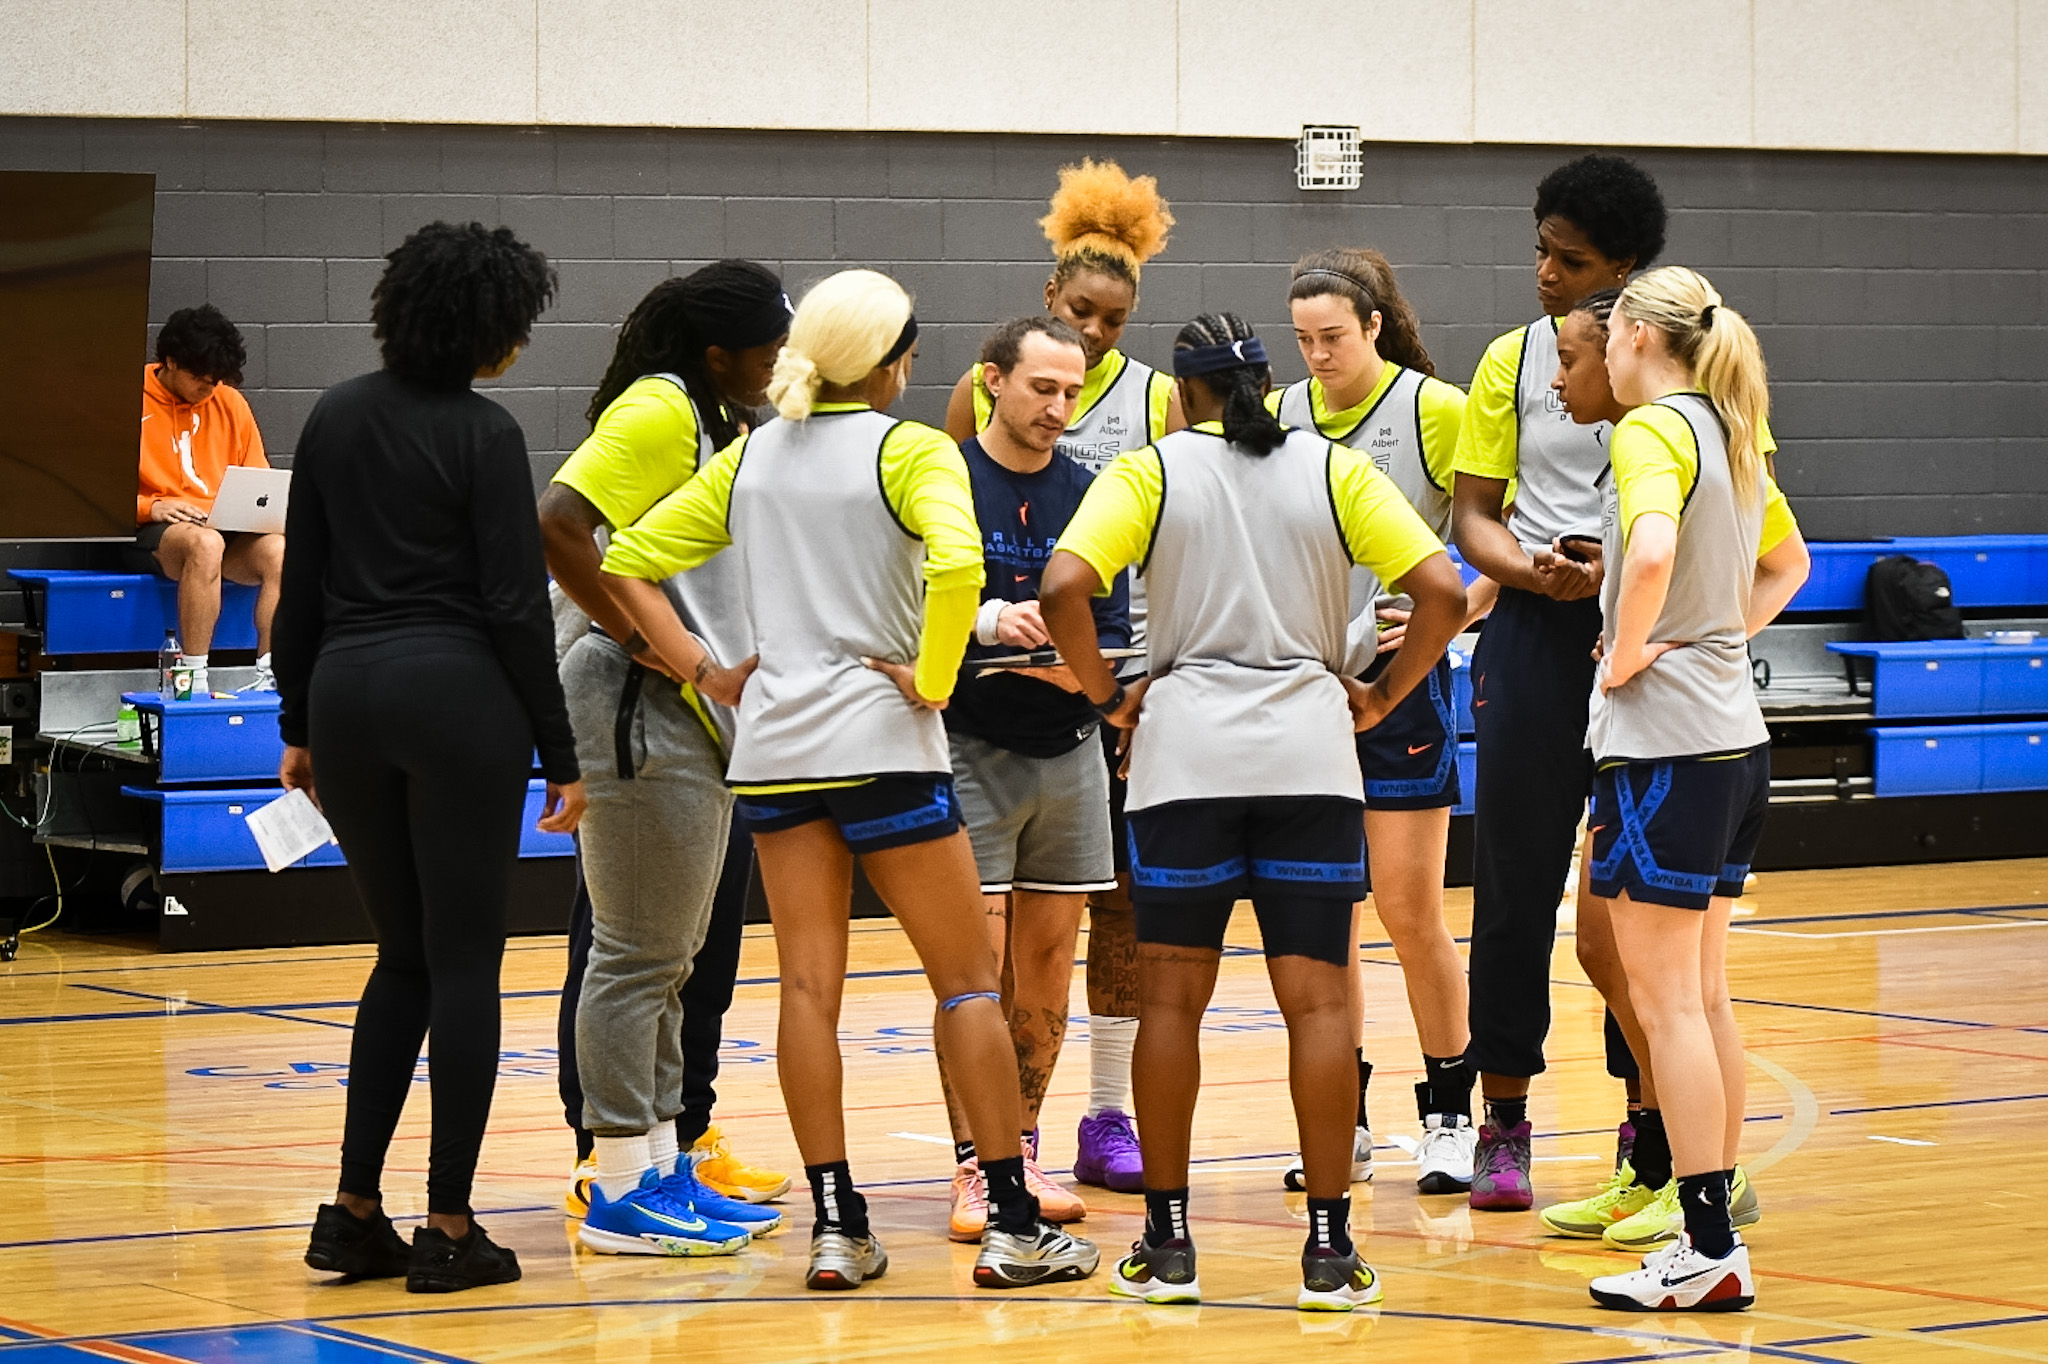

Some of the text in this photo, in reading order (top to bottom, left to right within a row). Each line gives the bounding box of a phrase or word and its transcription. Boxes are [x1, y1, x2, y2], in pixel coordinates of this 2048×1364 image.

[1099, 426, 1128, 436] Albert
[1371, 438, 1399, 448] Albert
[1274, 866, 1324, 877] WNBA
[1652, 874, 1694, 889] WNBA
